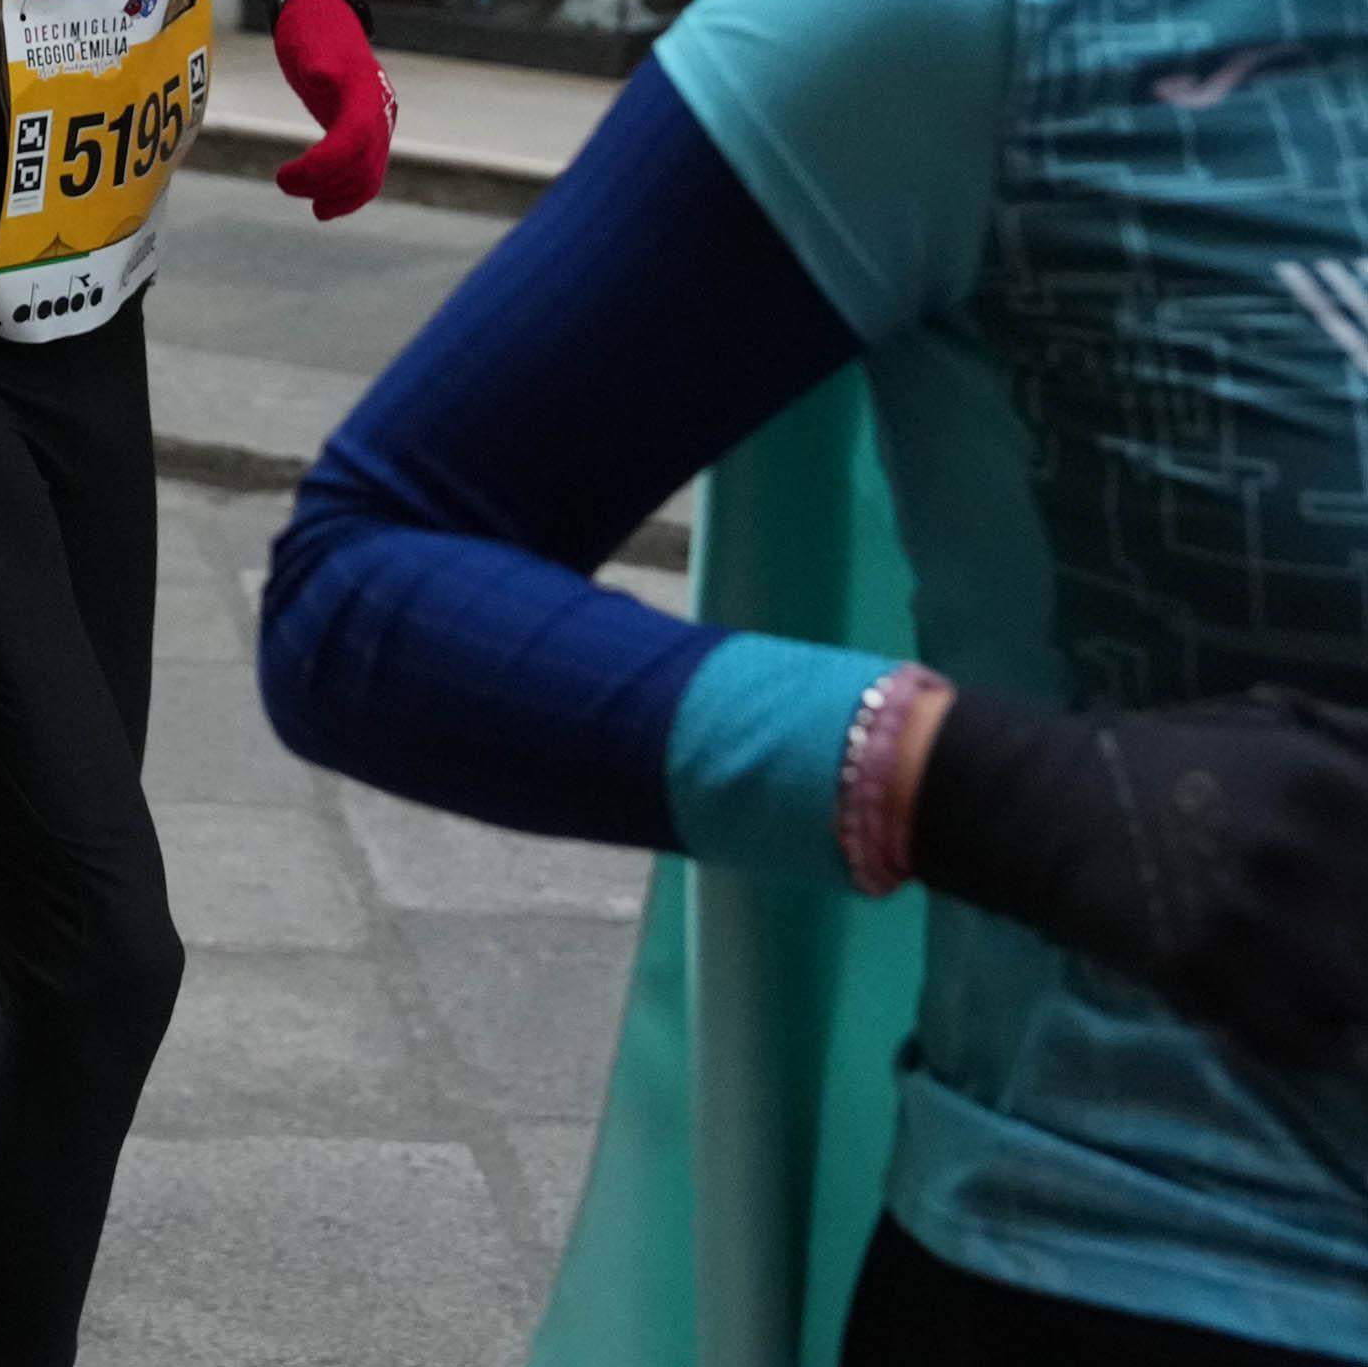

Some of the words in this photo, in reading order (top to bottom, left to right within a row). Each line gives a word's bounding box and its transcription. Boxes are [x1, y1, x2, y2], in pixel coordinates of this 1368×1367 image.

[27, 42, 75, 68] REGGIO
[80, 36, 128, 61] EMILIA
[59, 73, 183, 198] 5195
[12, 273, 105, 323] diadora
